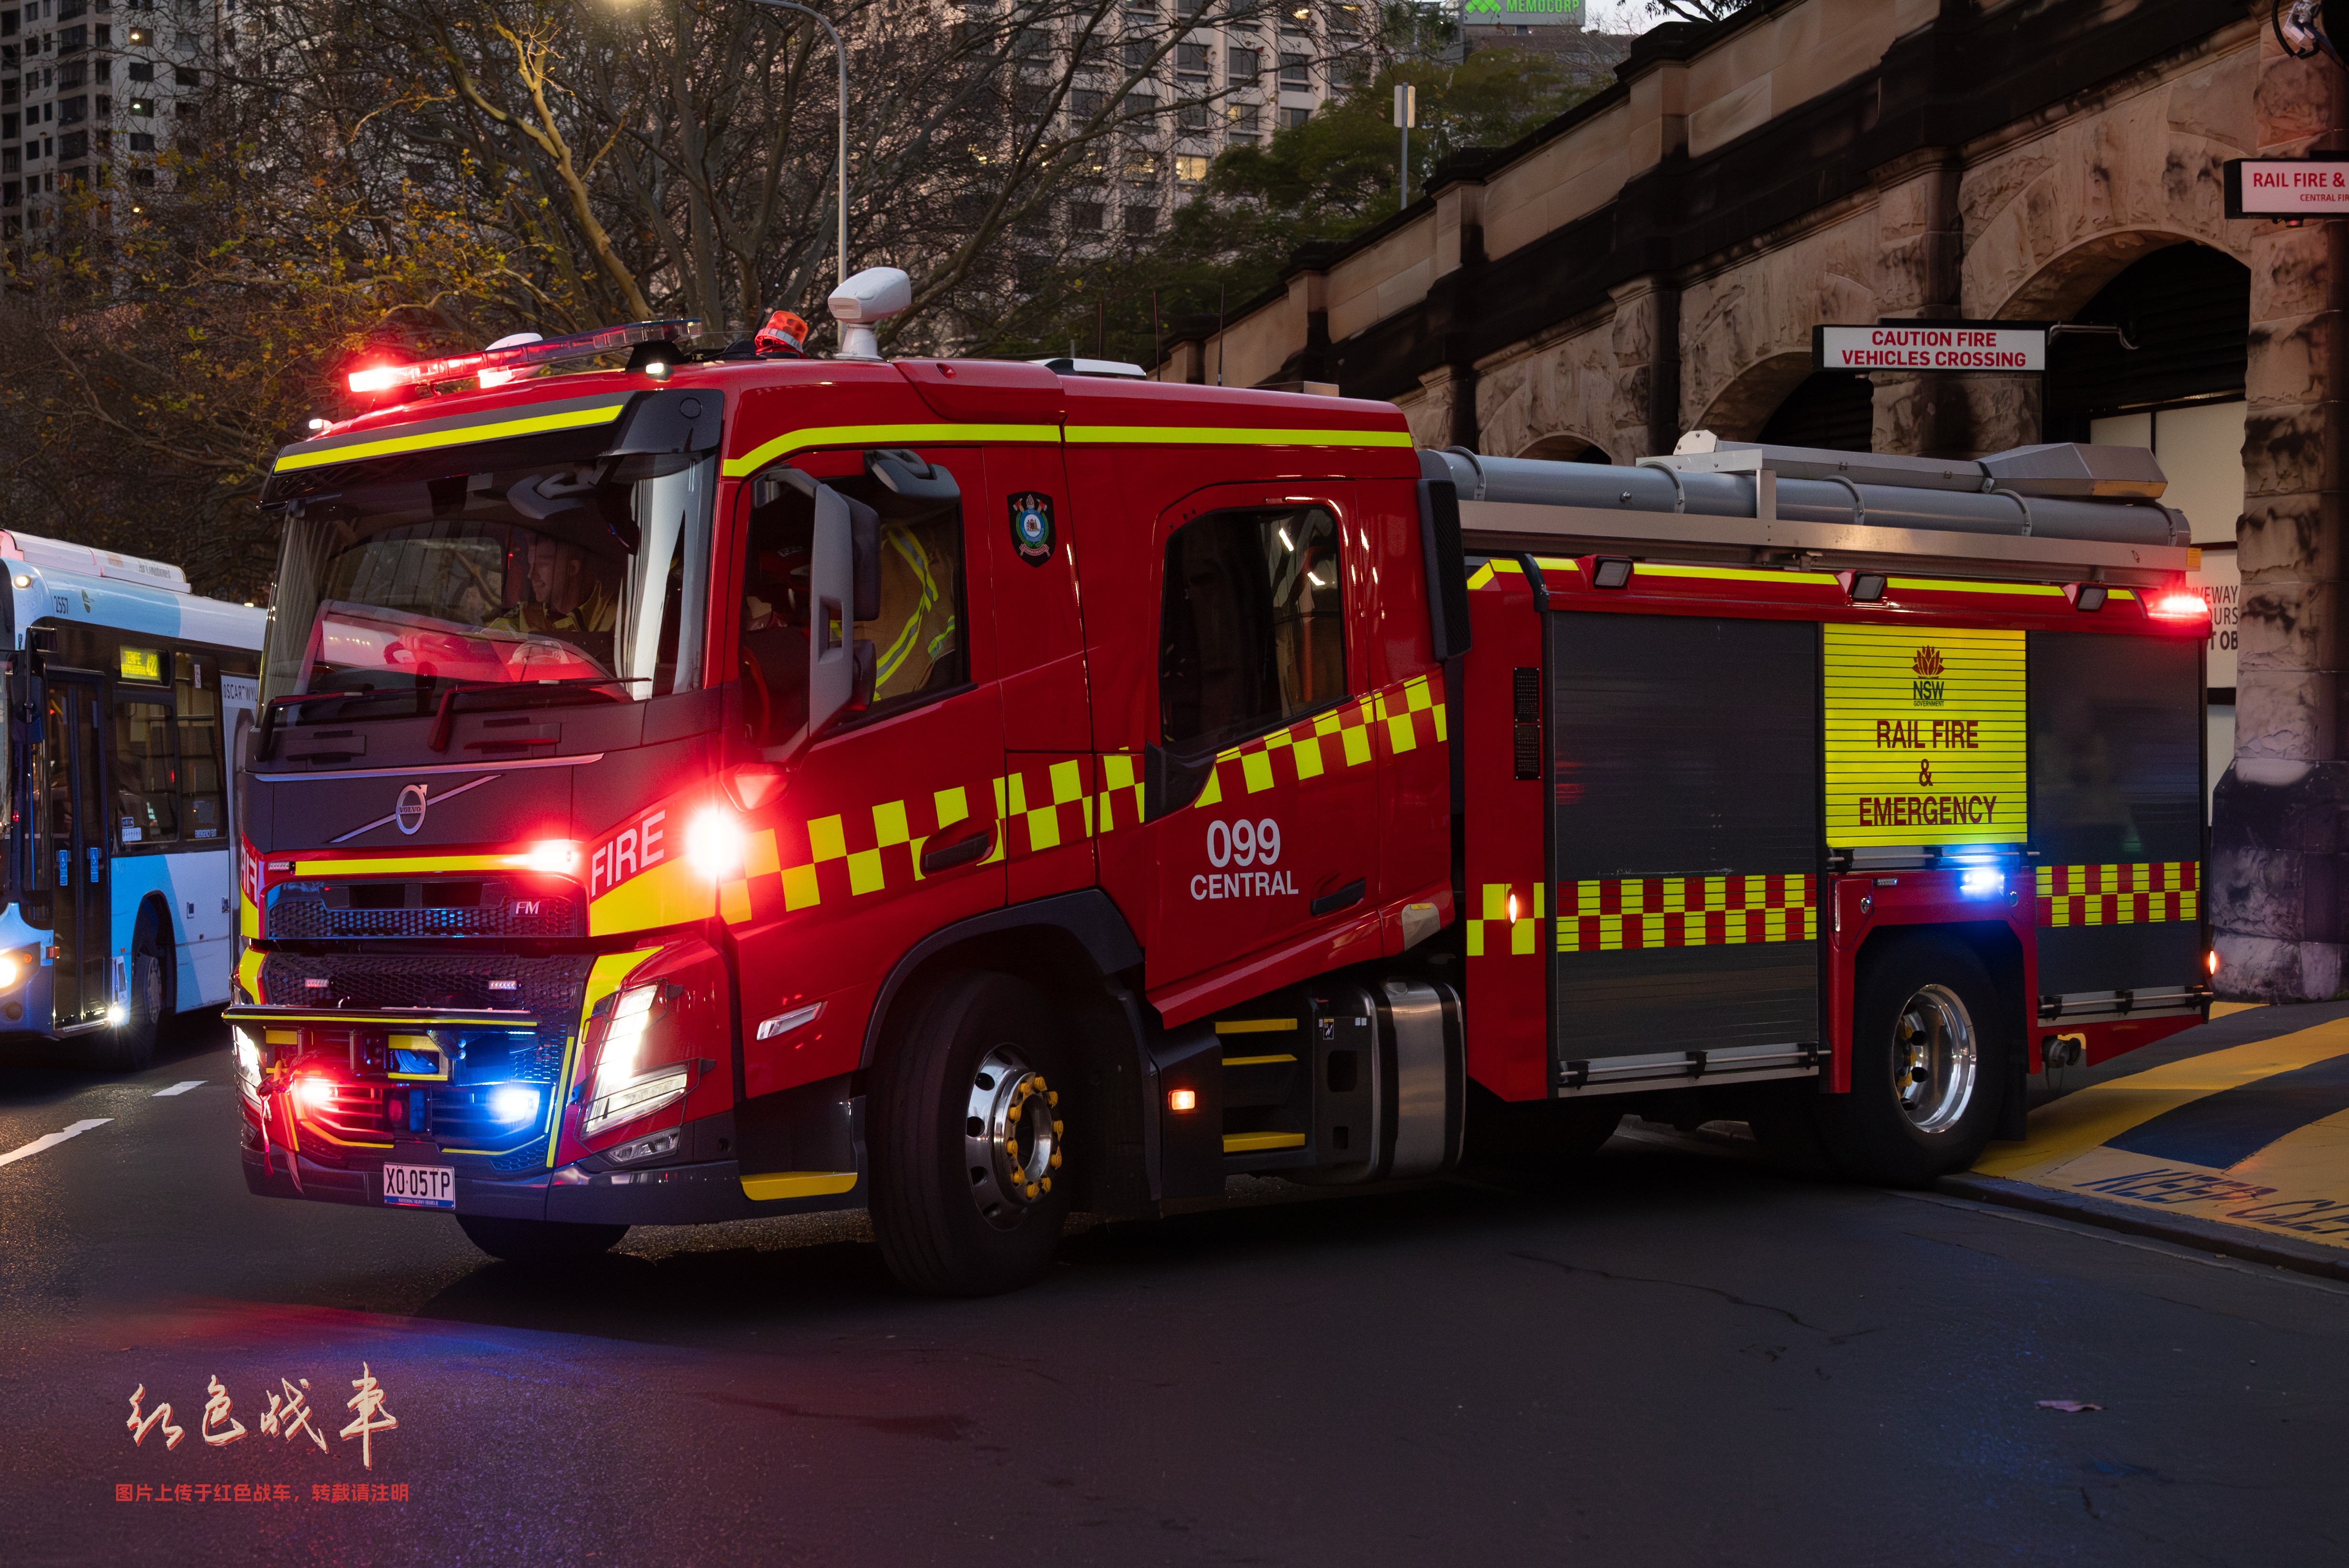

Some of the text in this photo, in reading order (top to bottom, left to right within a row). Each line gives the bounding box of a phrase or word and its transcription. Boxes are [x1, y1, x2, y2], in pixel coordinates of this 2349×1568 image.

[1507, 0, 1579, 12] MEMOCORP
[2253, 173, 2345, 187] RAIL FIRE &
[2300, 194, 2336, 202] CENTRAL
[1872, 330, 1997, 347] CAUTION FIRE
[1842, 350, 2026, 367] VEHICLES CROSSING
[54, 595, 68, 614] 2557
[223, 684, 258, 702] OSCAR WYL
[1913, 680, 1944, 700] NSW
[1877, 720, 1979, 748] RAIL FIRE
[1919, 758, 1933, 787] &
[1859, 795, 1997, 826] EMERGENCY
[1207, 818, 1281, 867] 099
[591, 809, 666, 898] FIRE
[1190, 870, 1299, 900] CENTRAL
[516, 901, 540, 914] FM
[2071, 1168, 2279, 1204] KEEP
